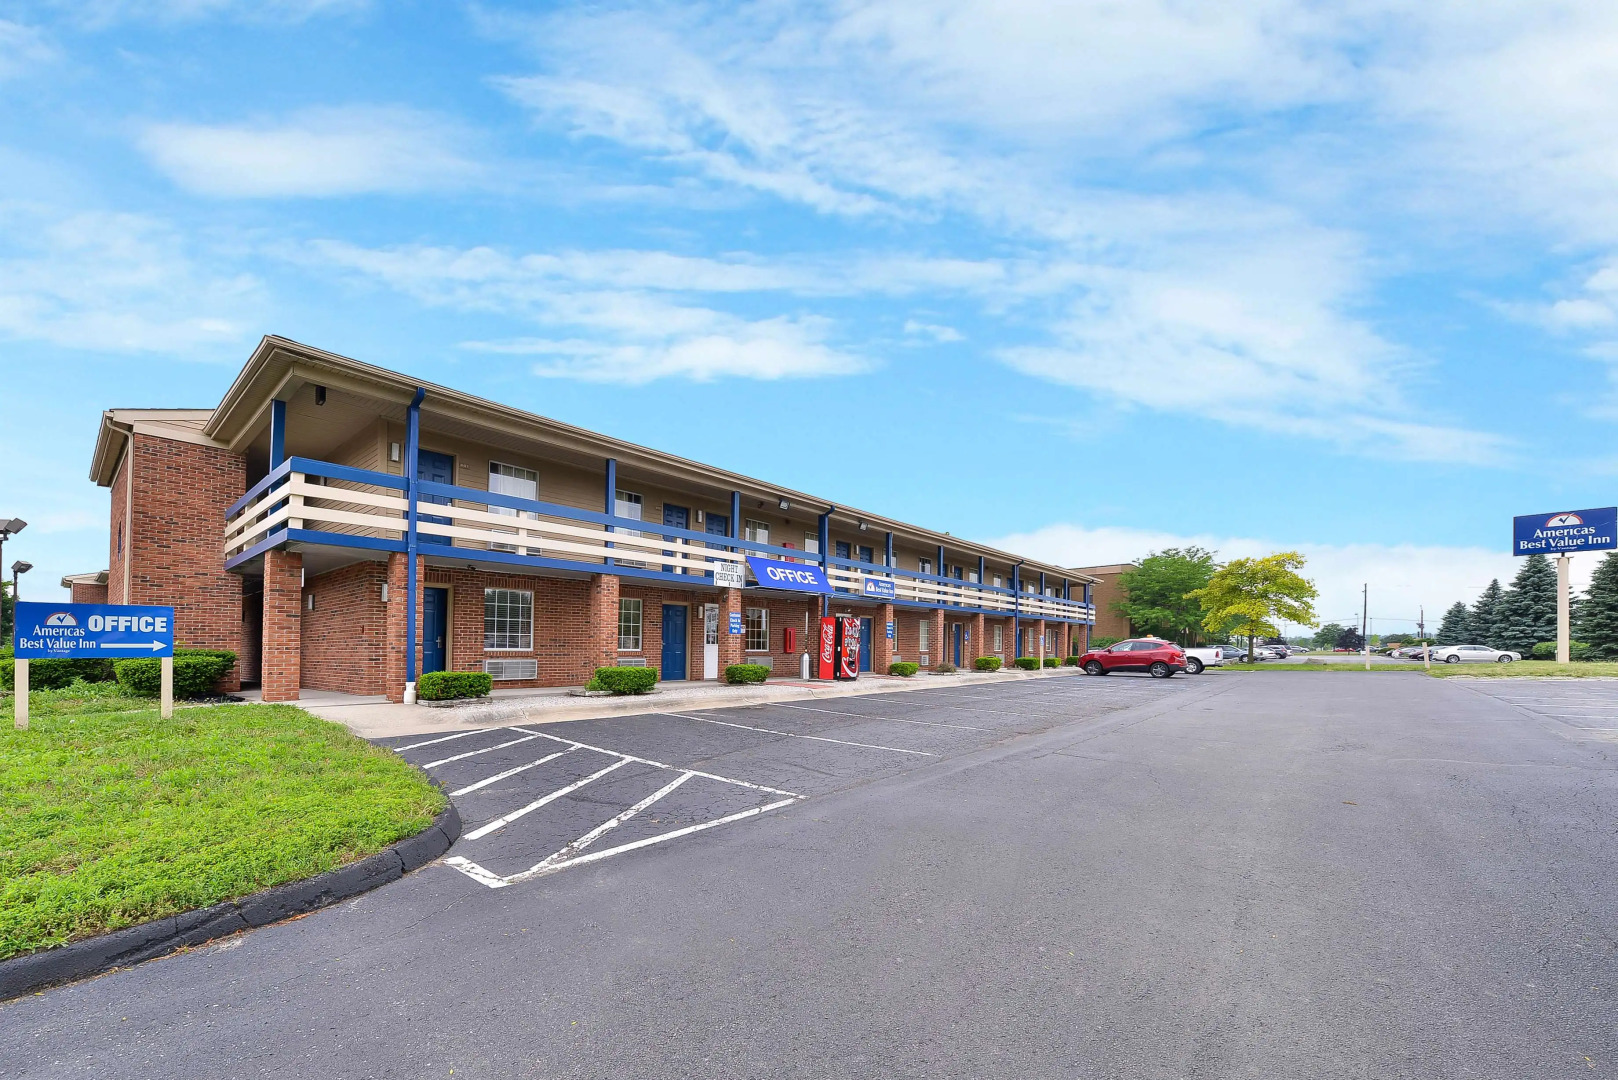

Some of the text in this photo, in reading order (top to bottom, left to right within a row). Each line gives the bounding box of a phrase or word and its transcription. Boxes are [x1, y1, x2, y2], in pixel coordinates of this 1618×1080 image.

[1533, 526, 1595, 538] Americas
[1520, 535, 1610, 550] Best Value Inn
[720, 562, 738, 573] NIGHT
[715, 571, 742, 583] CHECK IN
[766, 566, 818, 585] OFFICE
[88, 615, 167, 632] OFFICE
[33, 624, 85, 636] Americas
[20, 638, 96, 649] Best Value Inn
